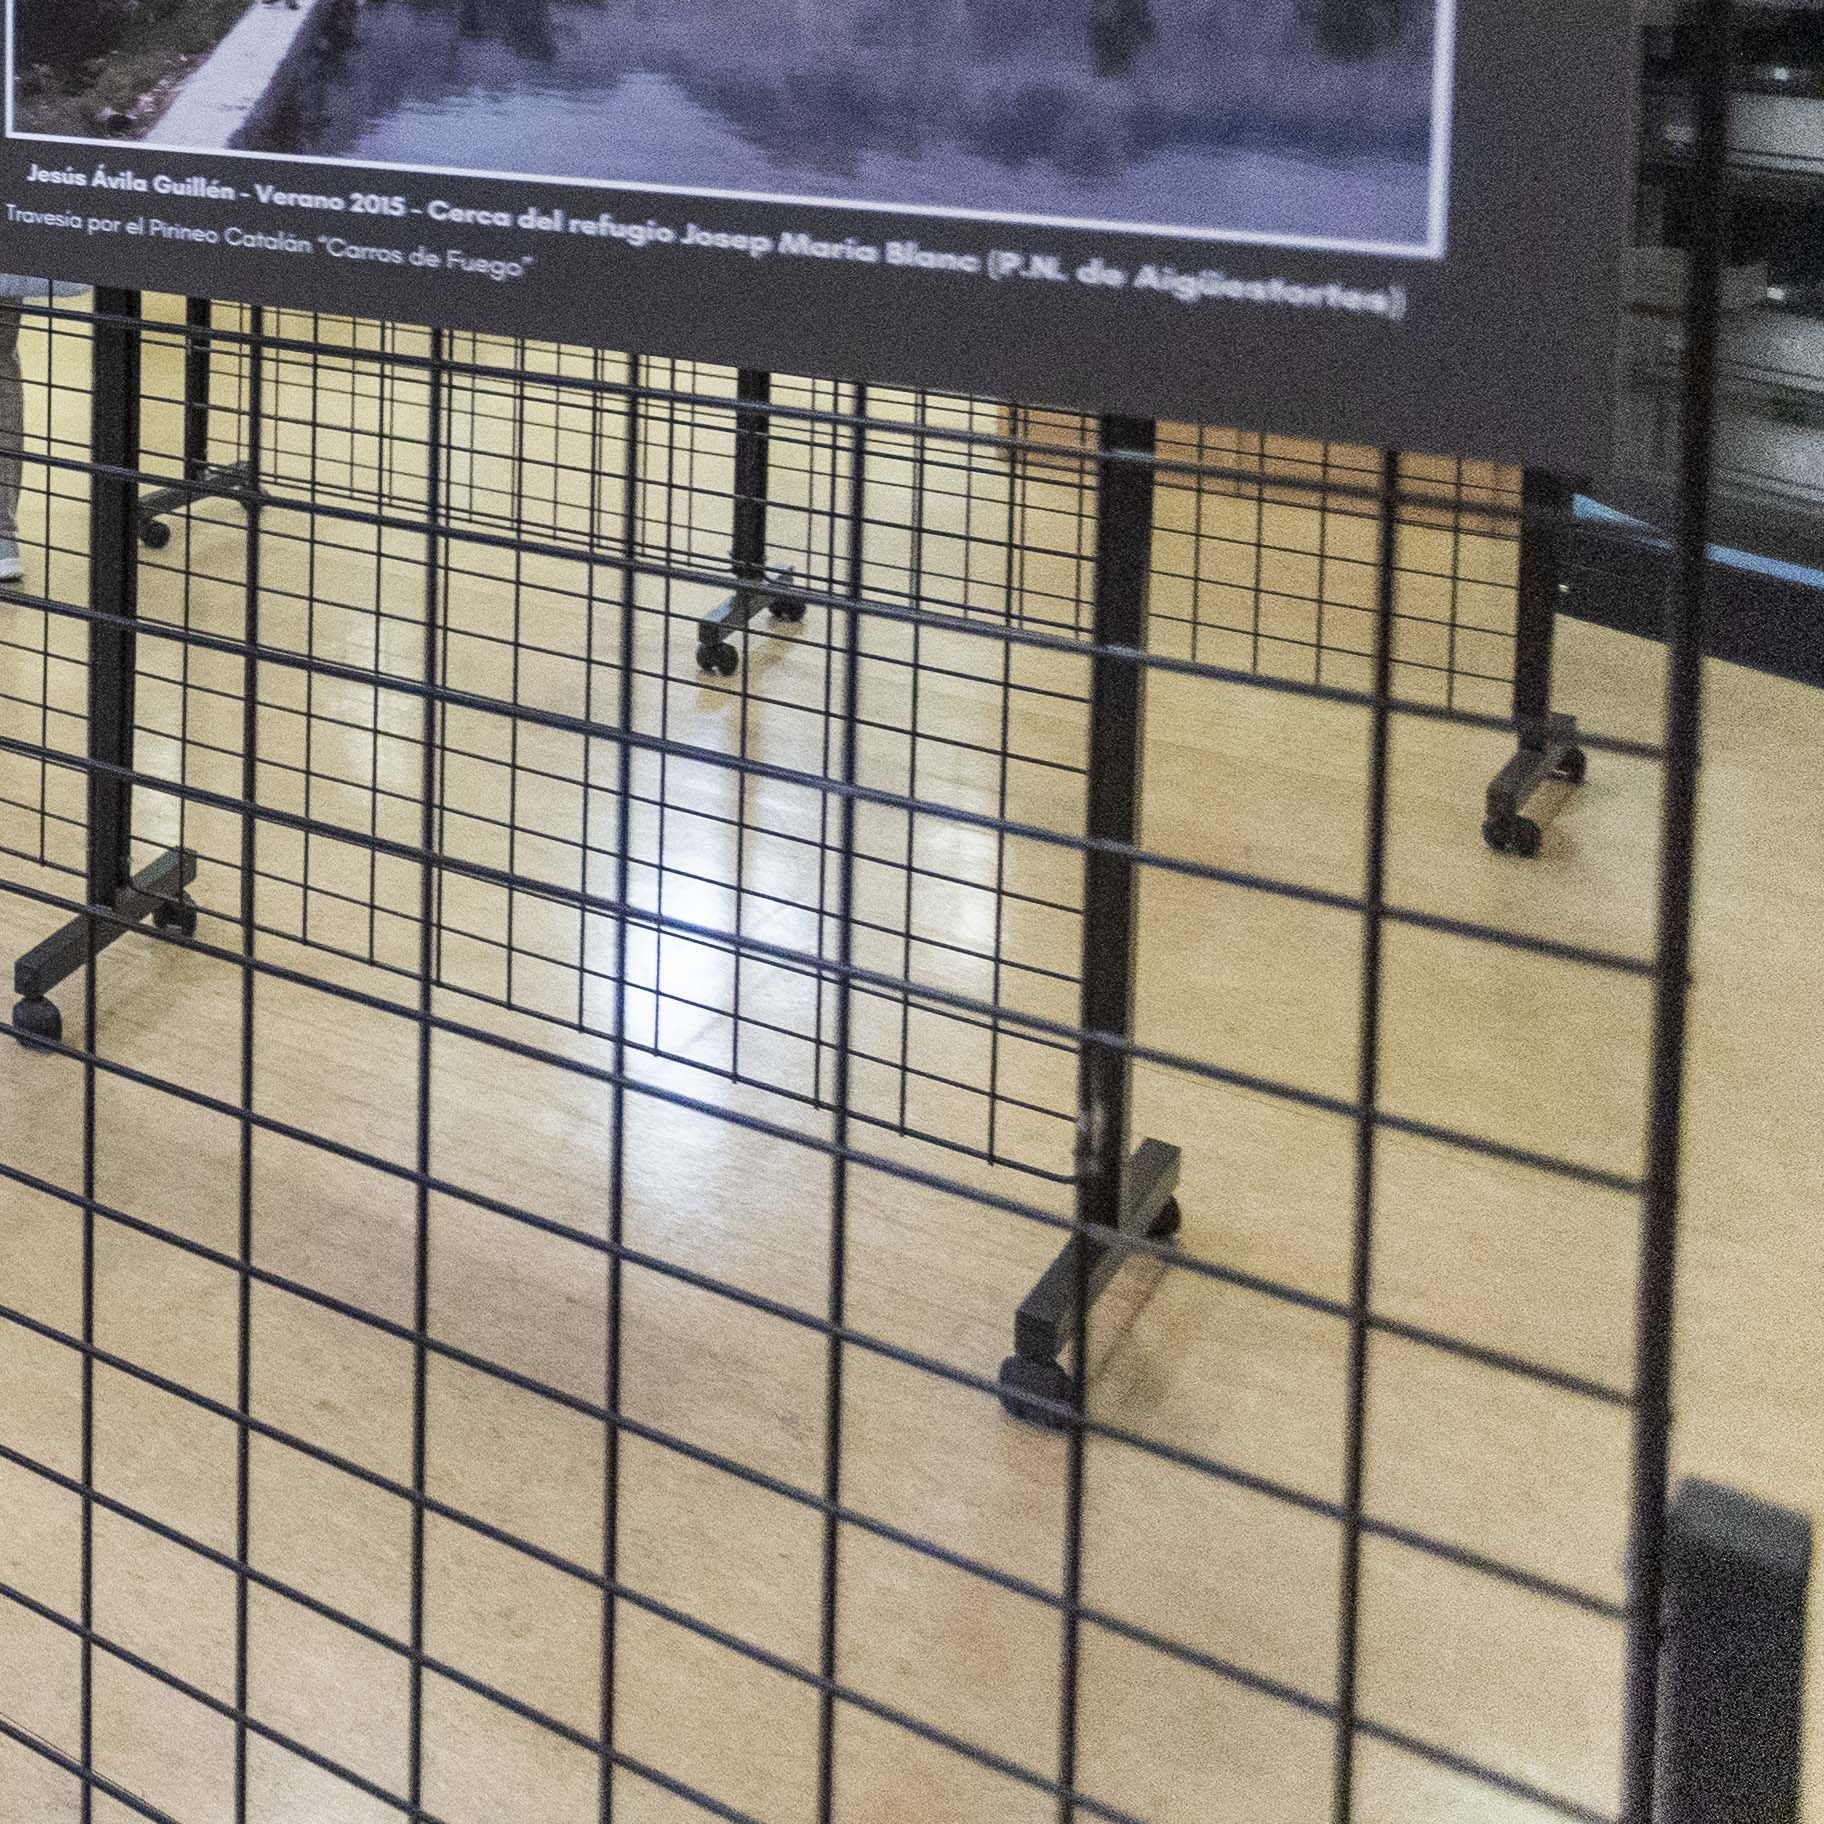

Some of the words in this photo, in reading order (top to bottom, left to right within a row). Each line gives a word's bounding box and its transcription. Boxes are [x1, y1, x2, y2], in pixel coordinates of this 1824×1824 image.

[27, 164, 87, 186] Jesús
[91, 164, 148, 192] Ávila
[152, 174, 236, 200] Guillén
[255, 183, 345, 211] Verano
[349, 192, 406, 216] 2015
[427, 200, 512, 227] Cerca
[517, 207, 563, 232] del
[569, 212, 676, 247] refugio
[680, 222, 773, 259] Josep
[885, 240, 982, 273] Blanc
[1076, 256, 1127, 287] de
[88, 217, 121, 235] por
[125, 216, 143, 235] el
[149, 219, 219, 244] Pirineo
[223, 226, 313, 253] Catalán
[409, 245, 440, 268] de
